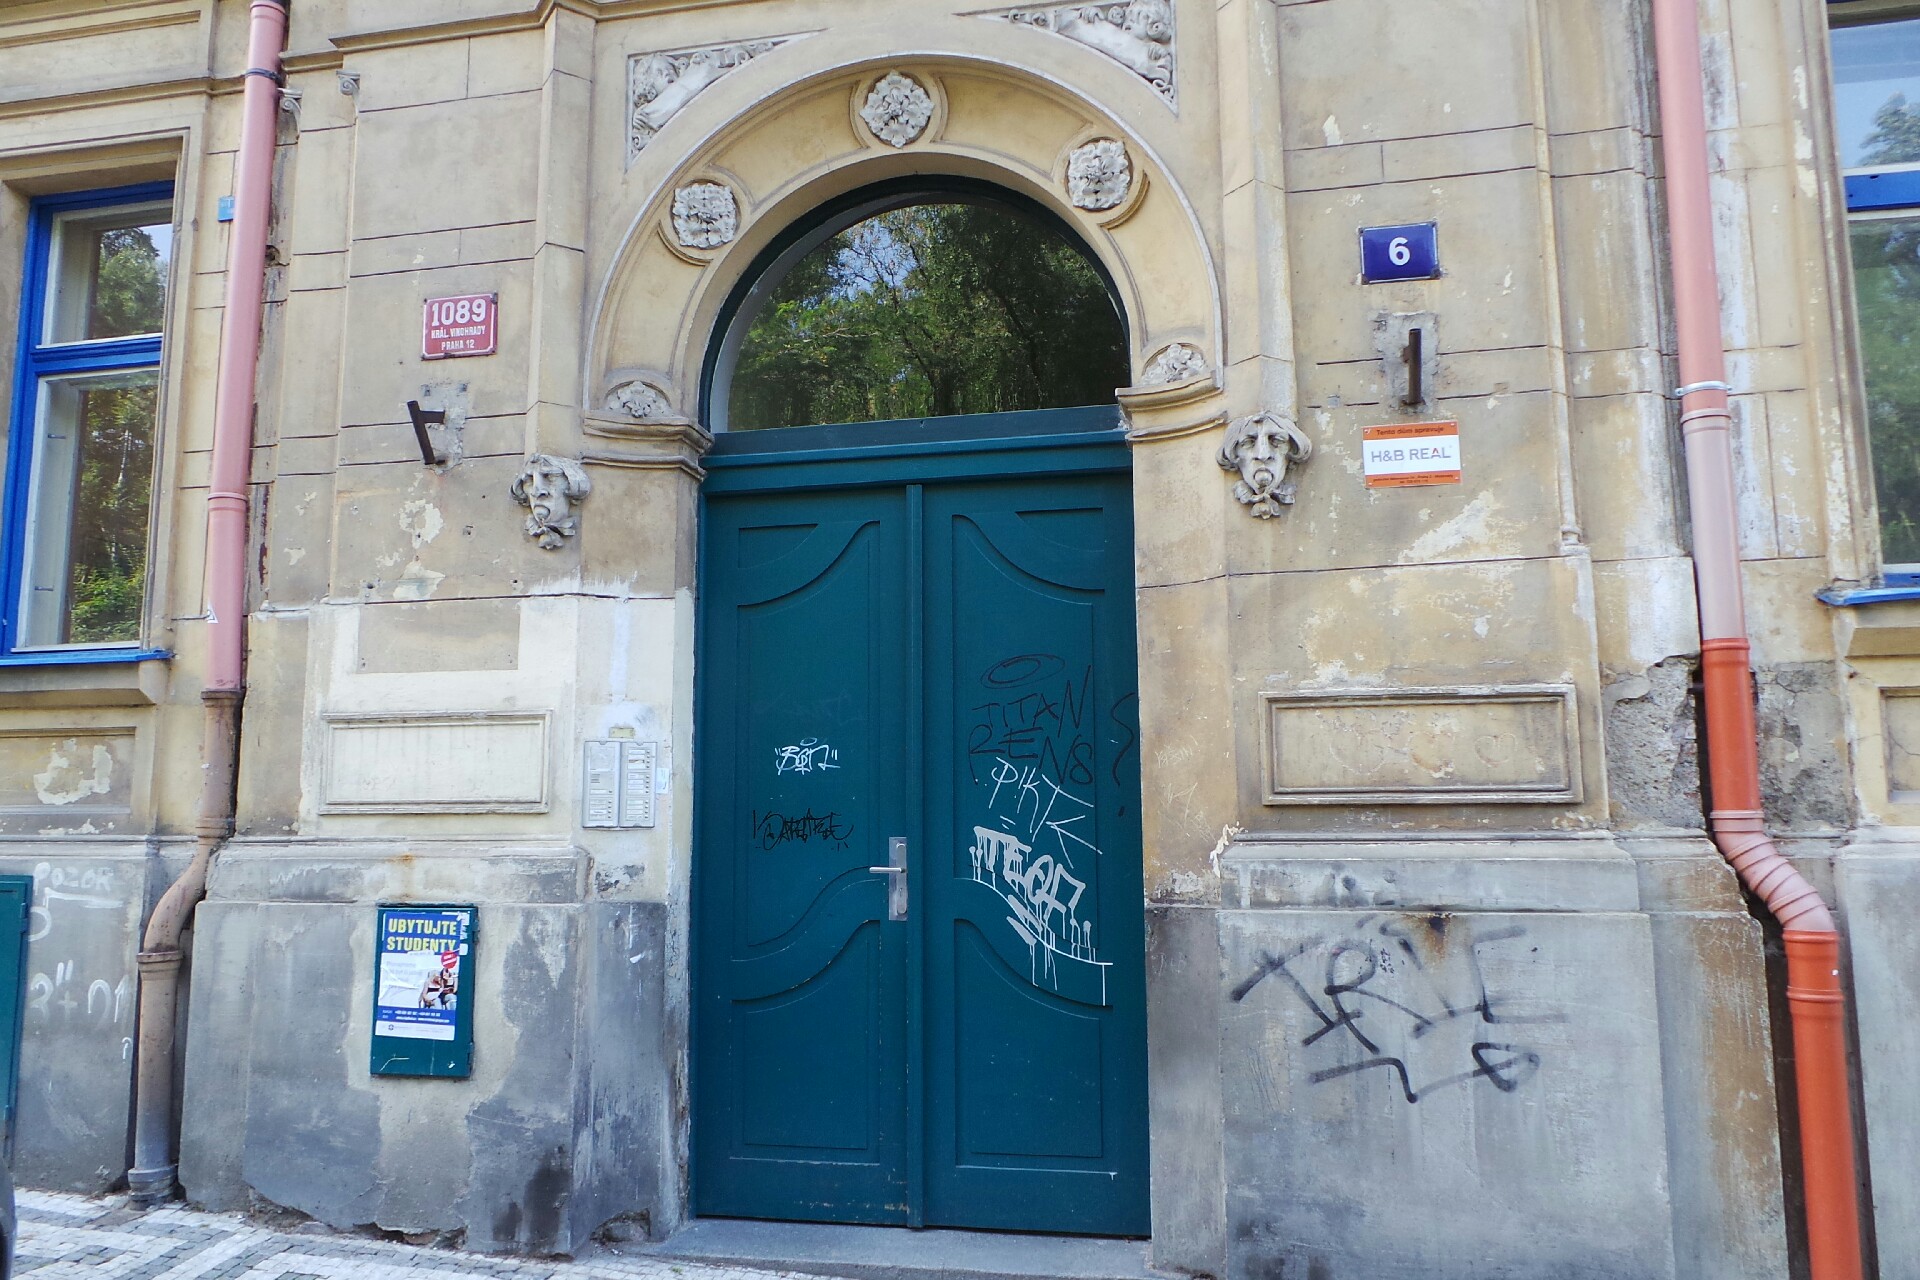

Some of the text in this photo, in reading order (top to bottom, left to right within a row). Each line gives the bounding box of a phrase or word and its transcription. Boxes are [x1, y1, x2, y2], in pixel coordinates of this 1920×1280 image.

[1388, 236, 1411, 266] 6
[431, 298, 486, 327] 1089
[450, 325, 486, 337] VINOHRADY
[441, 339, 475, 350] PRAHA 12
[1371, 447, 1451, 462] H&B REAL
[387, 918, 457, 936] UBYTUJTE
[386, 936, 457, 953] STUDENTY
